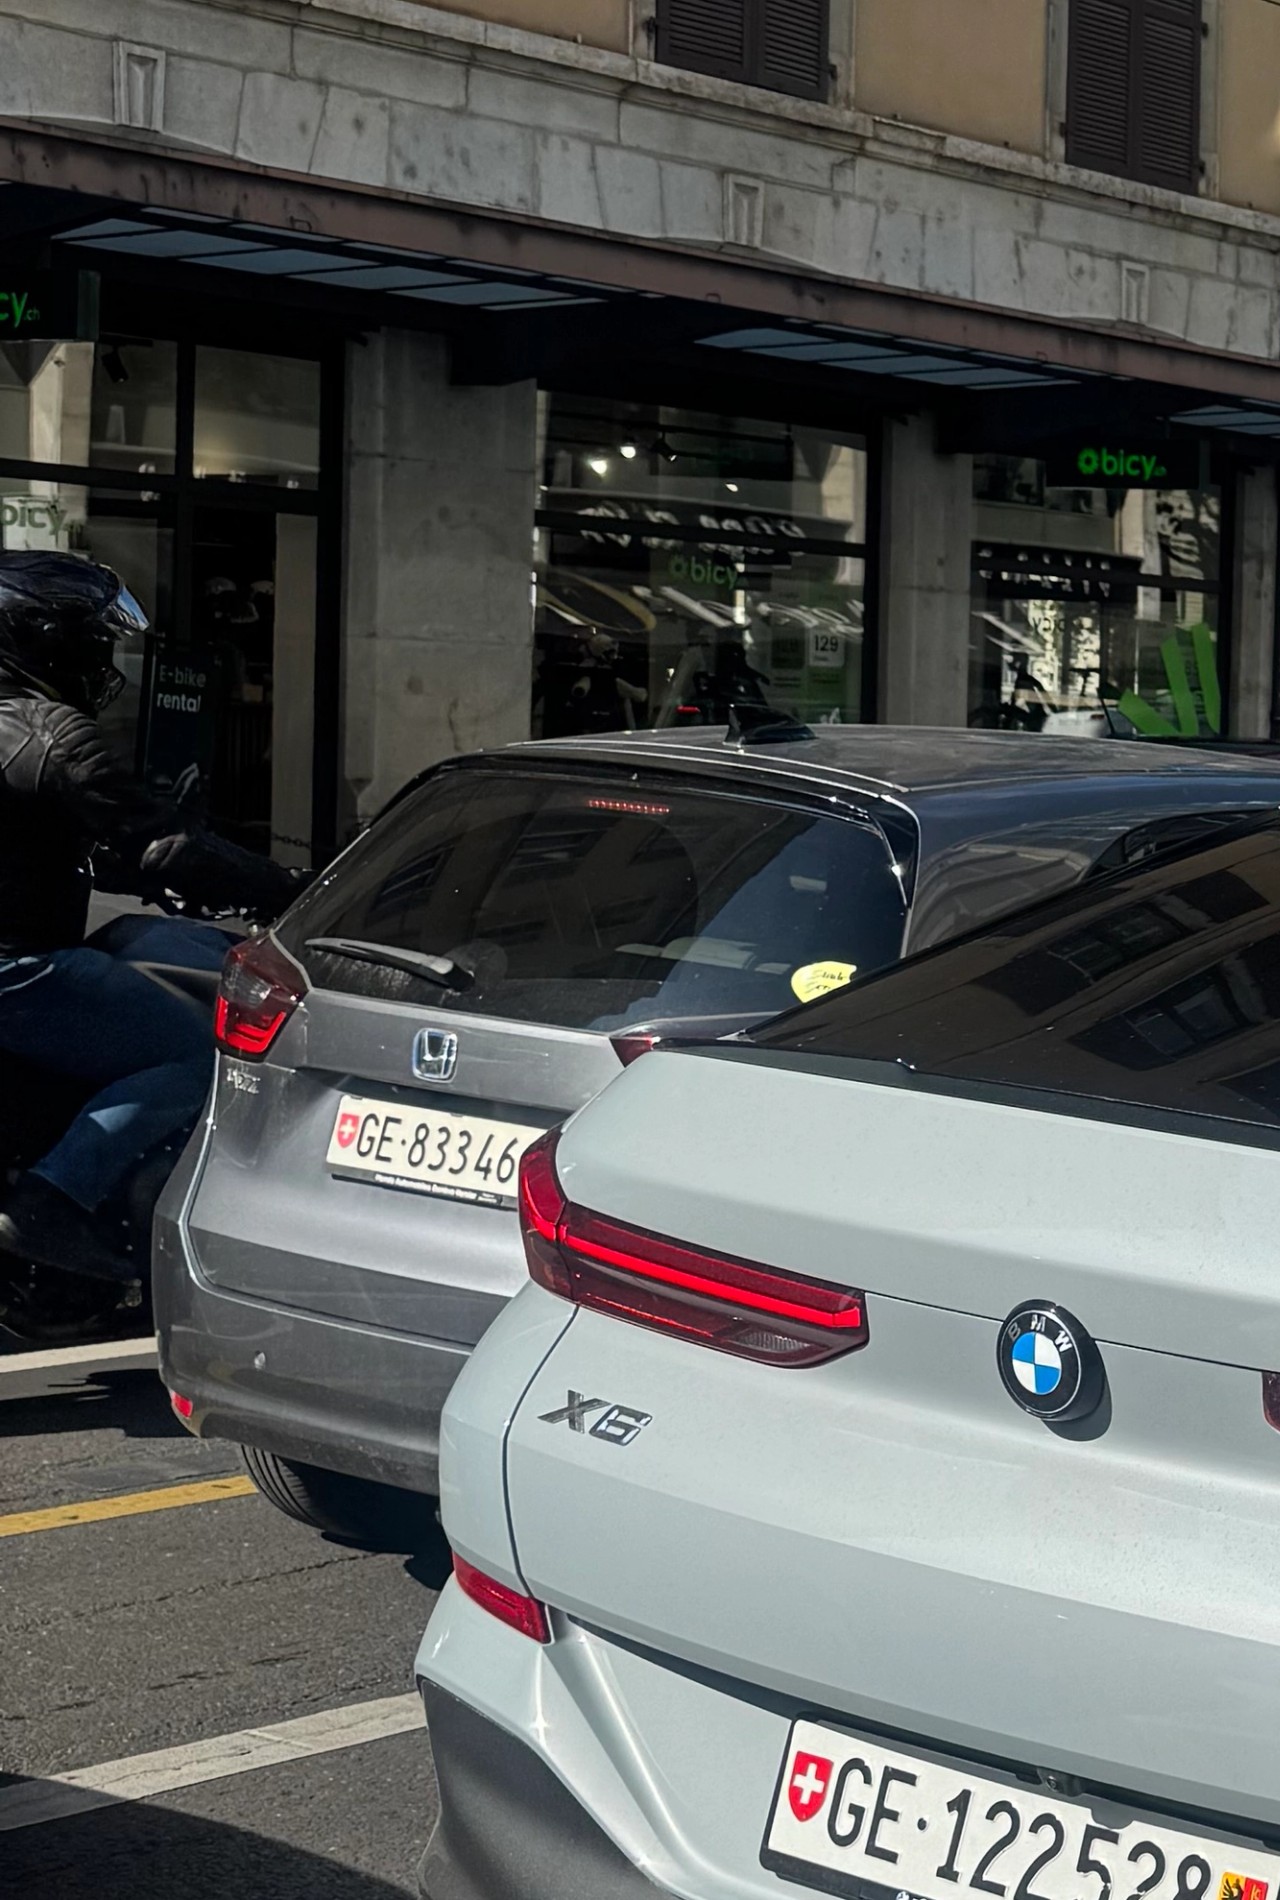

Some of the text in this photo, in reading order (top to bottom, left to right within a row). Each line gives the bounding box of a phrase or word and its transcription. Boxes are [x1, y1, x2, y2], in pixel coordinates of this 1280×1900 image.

[815, 634, 838, 652] 129
[160, 664, 206, 688] E-bike
[157, 692, 201, 712] rental
[1008, 1314, 1072, 1352] BMW
[537, 1389, 653, 1447] X6
